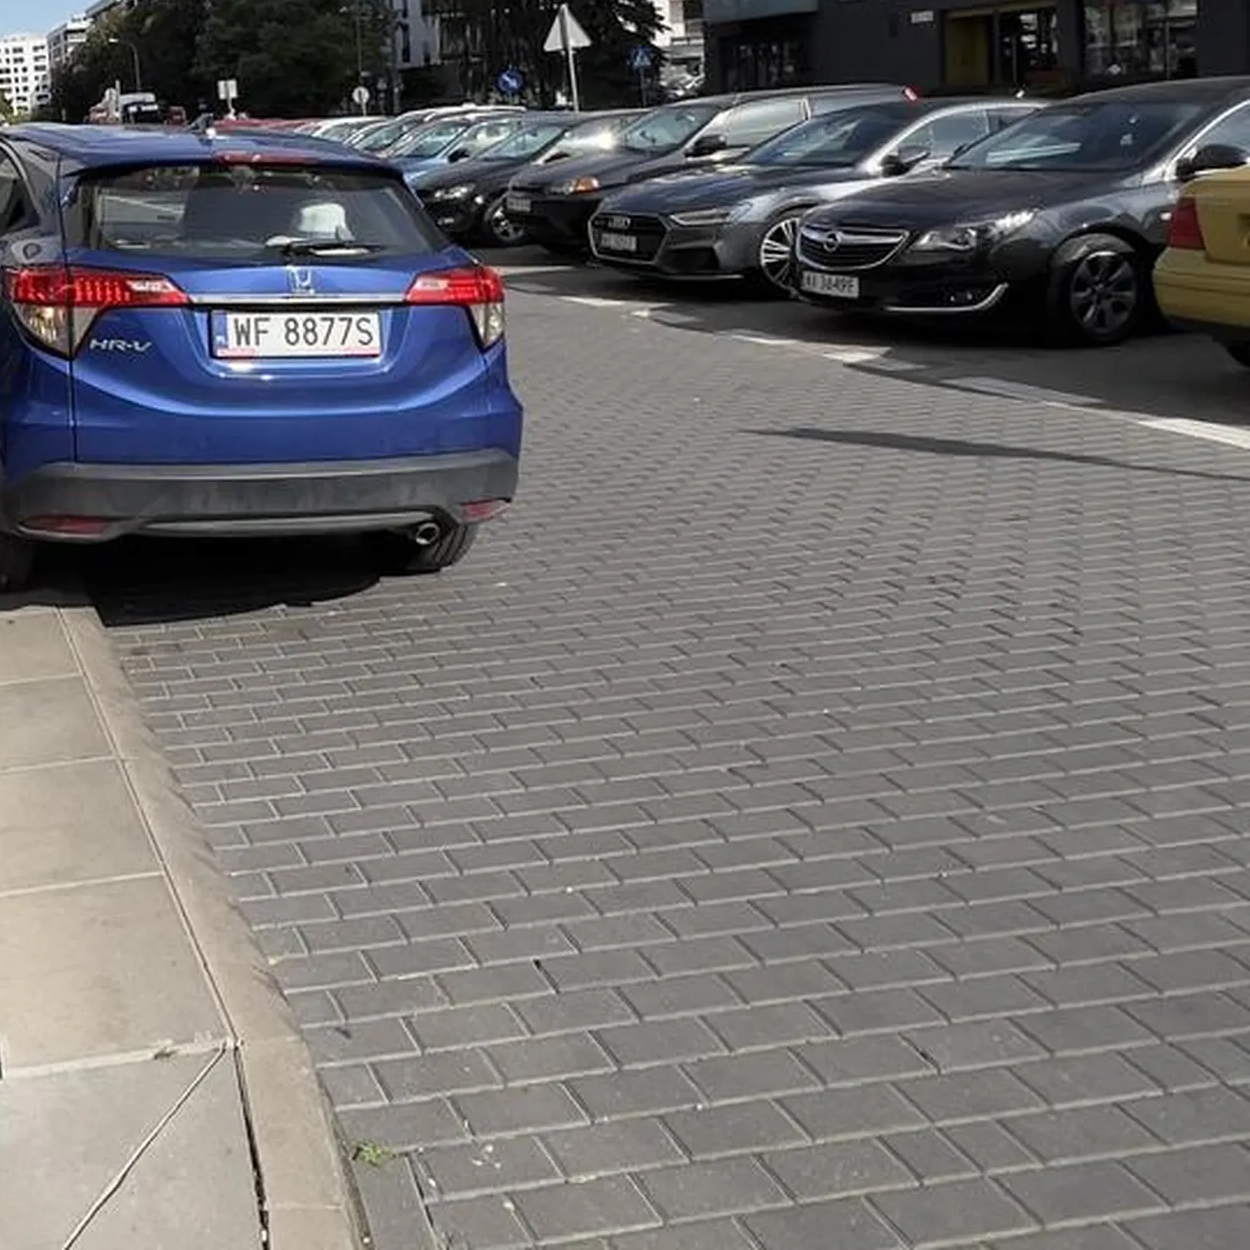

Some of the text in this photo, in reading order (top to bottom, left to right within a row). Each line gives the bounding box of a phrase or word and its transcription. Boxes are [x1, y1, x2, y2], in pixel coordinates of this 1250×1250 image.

[233, 316, 374, 347] WF 8877S
[89, 337, 153, 352] HR-V
